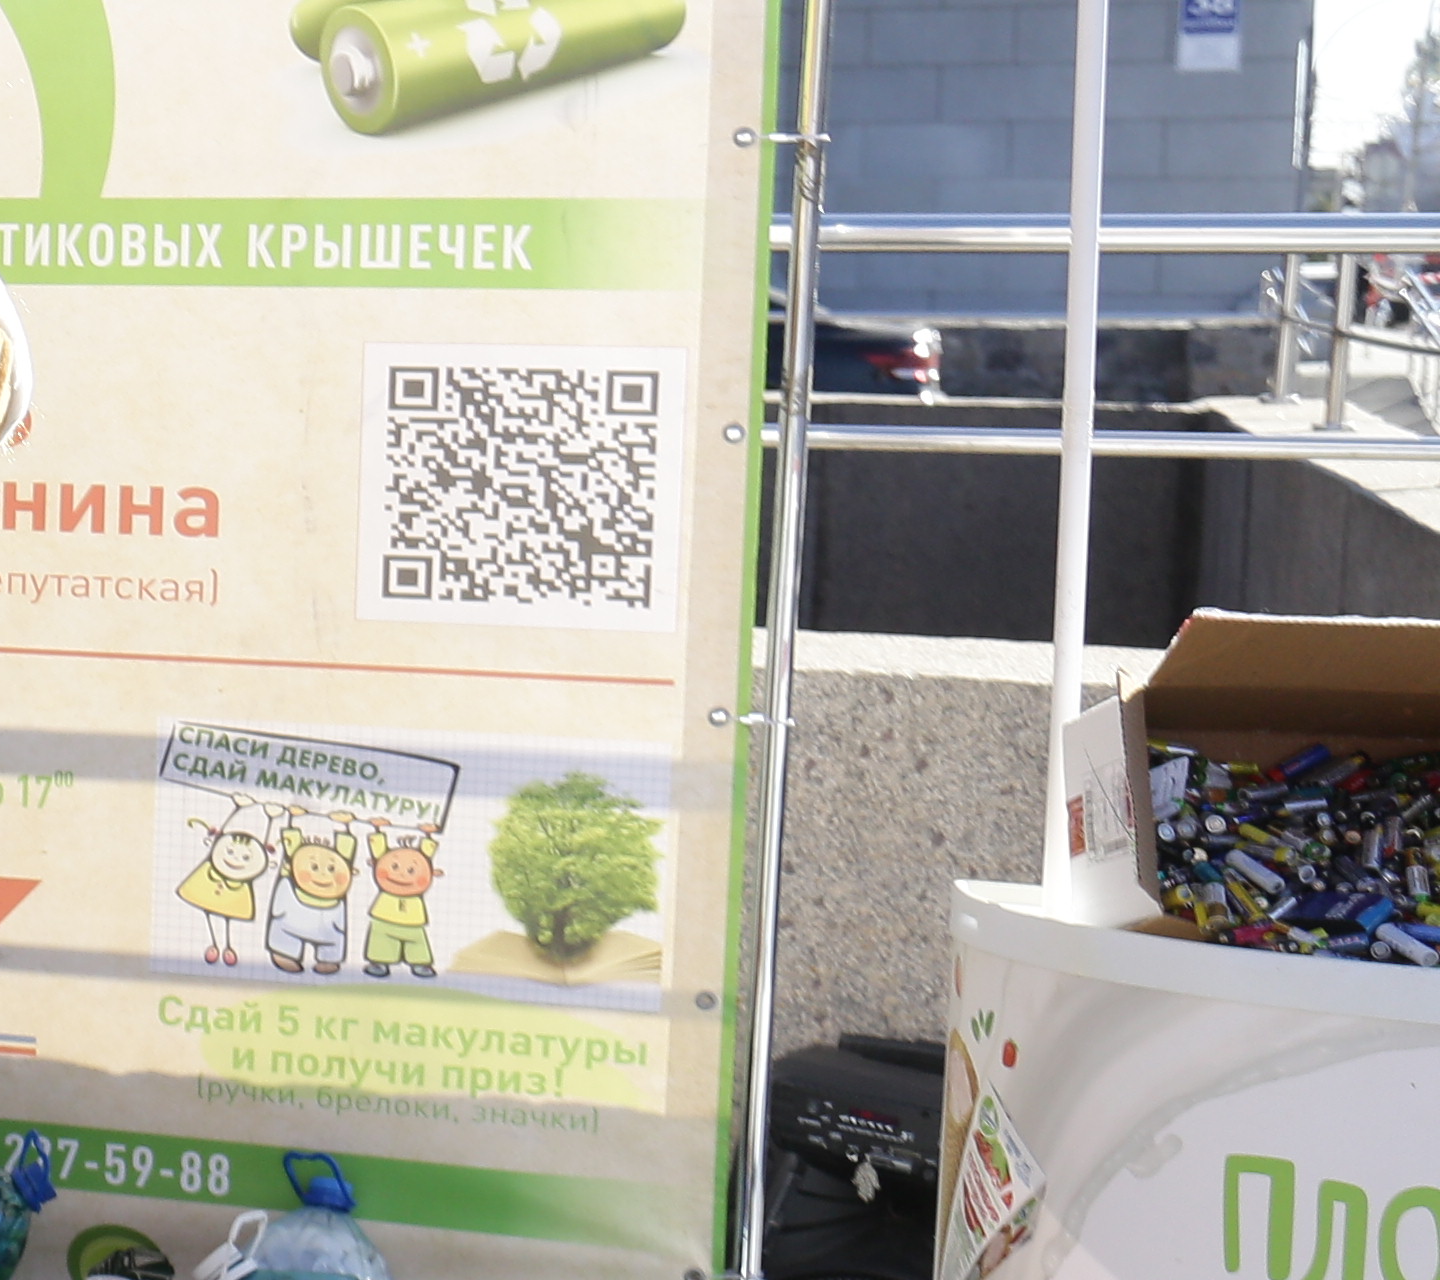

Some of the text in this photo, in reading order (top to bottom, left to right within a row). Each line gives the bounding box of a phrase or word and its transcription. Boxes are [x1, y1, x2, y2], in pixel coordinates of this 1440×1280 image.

[247, 223, 533, 272] КРЫШЕЧЕК
[178, 725, 386, 785] СПАСИ ДЕРЕВО,
[172, 752, 442, 821] СДАЙ МАКУЛАТУРУ!
[157, 995, 647, 1069] Сдай 5 кг макулатуры
[231, 1046, 565, 1098] и получи приз!
[316, 1086, 459, 1124] брелоки,
